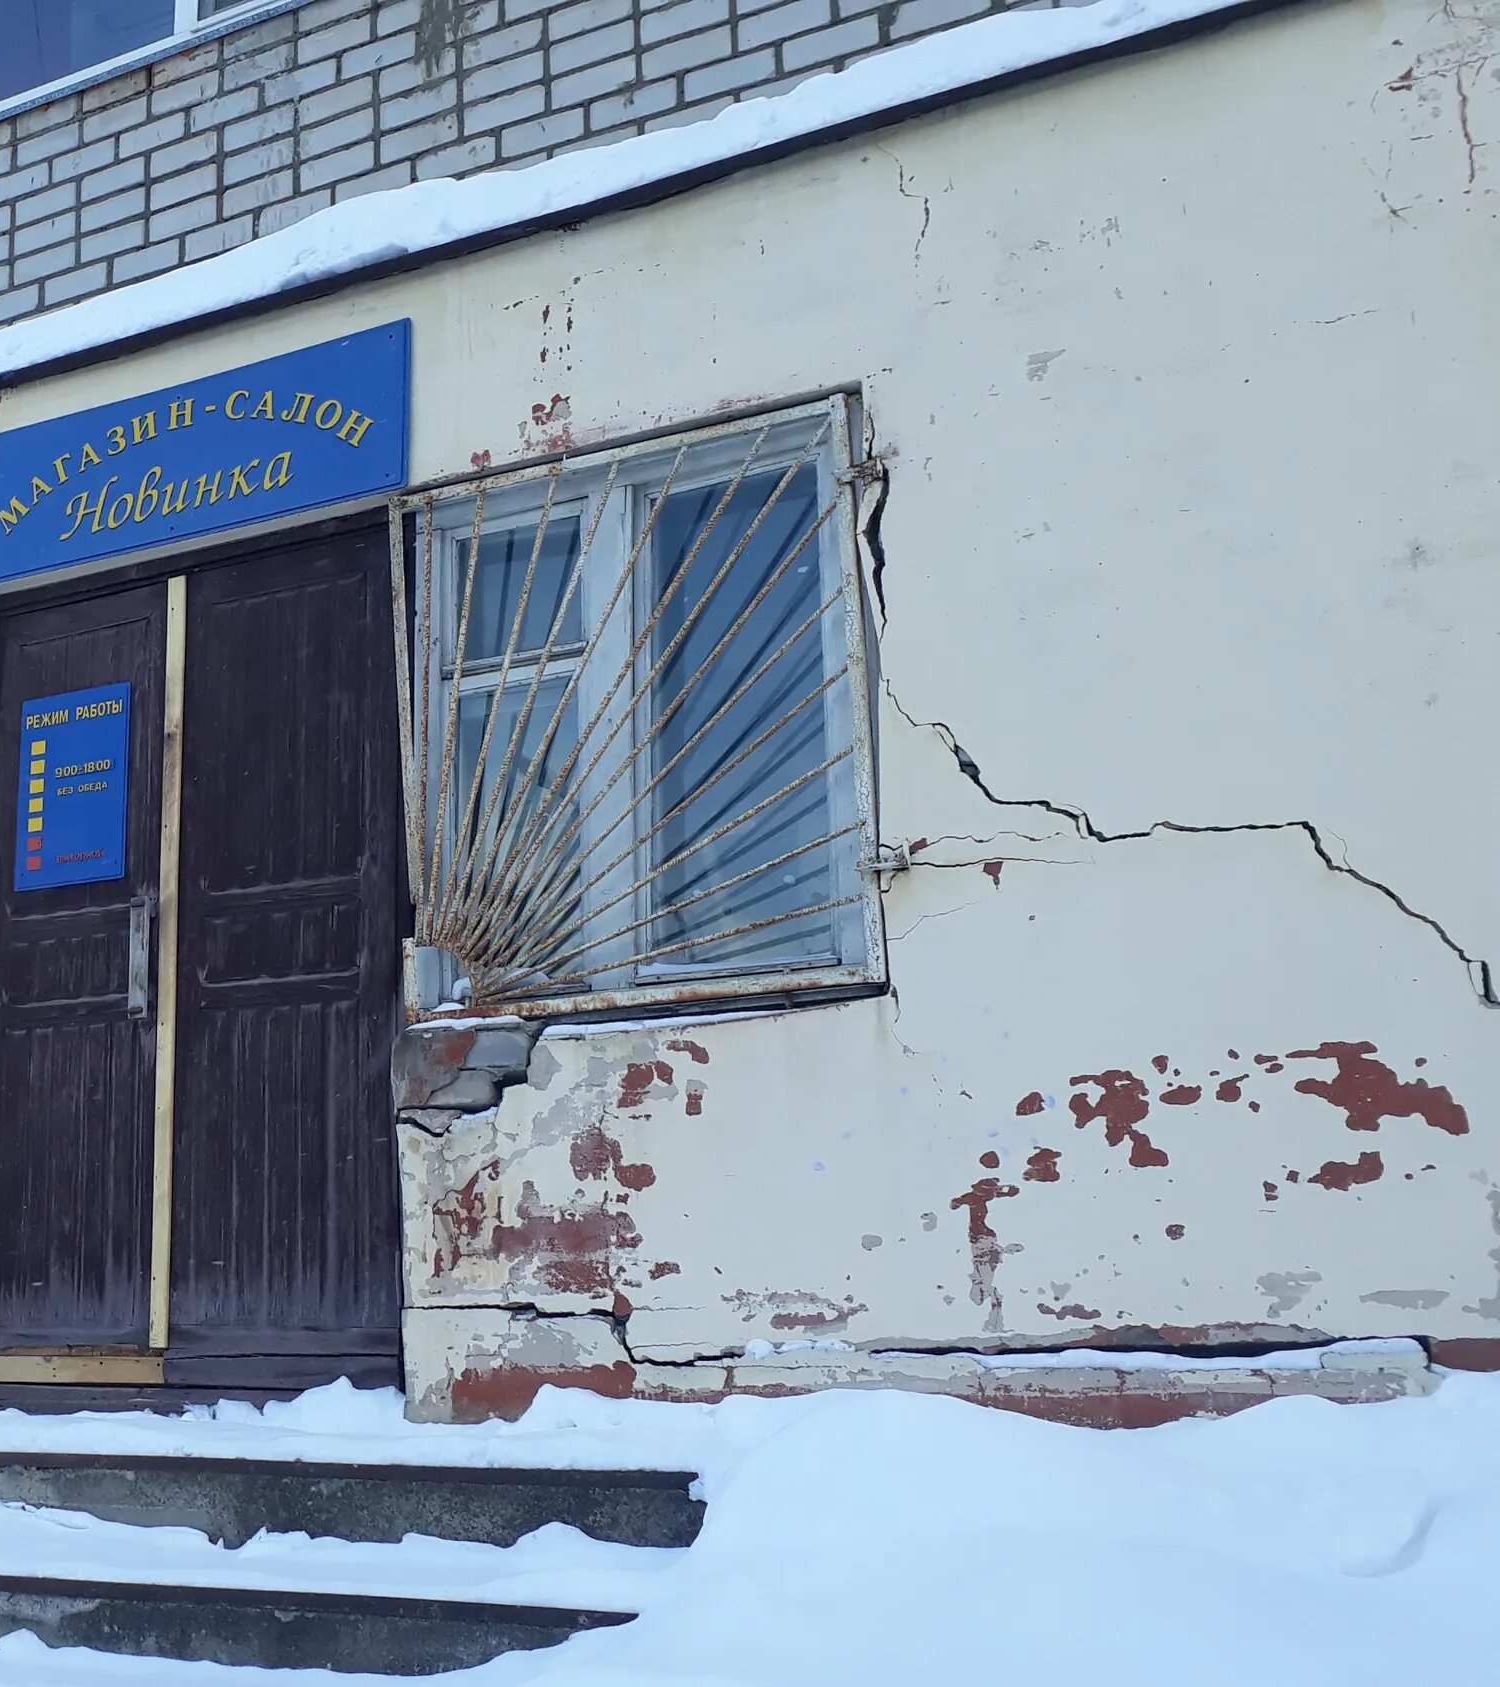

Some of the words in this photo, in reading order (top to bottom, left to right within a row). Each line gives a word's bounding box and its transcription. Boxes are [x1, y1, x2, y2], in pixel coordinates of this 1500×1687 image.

[59, 450, 295, 542] Новинка
[26, 708, 69, 730] РЕЖИМ
[75, 699, 123, 720] РАБОТЫ
[57, 786, 74, 796] БЕЗ
[78, 780, 108, 794] ОБЕДА
